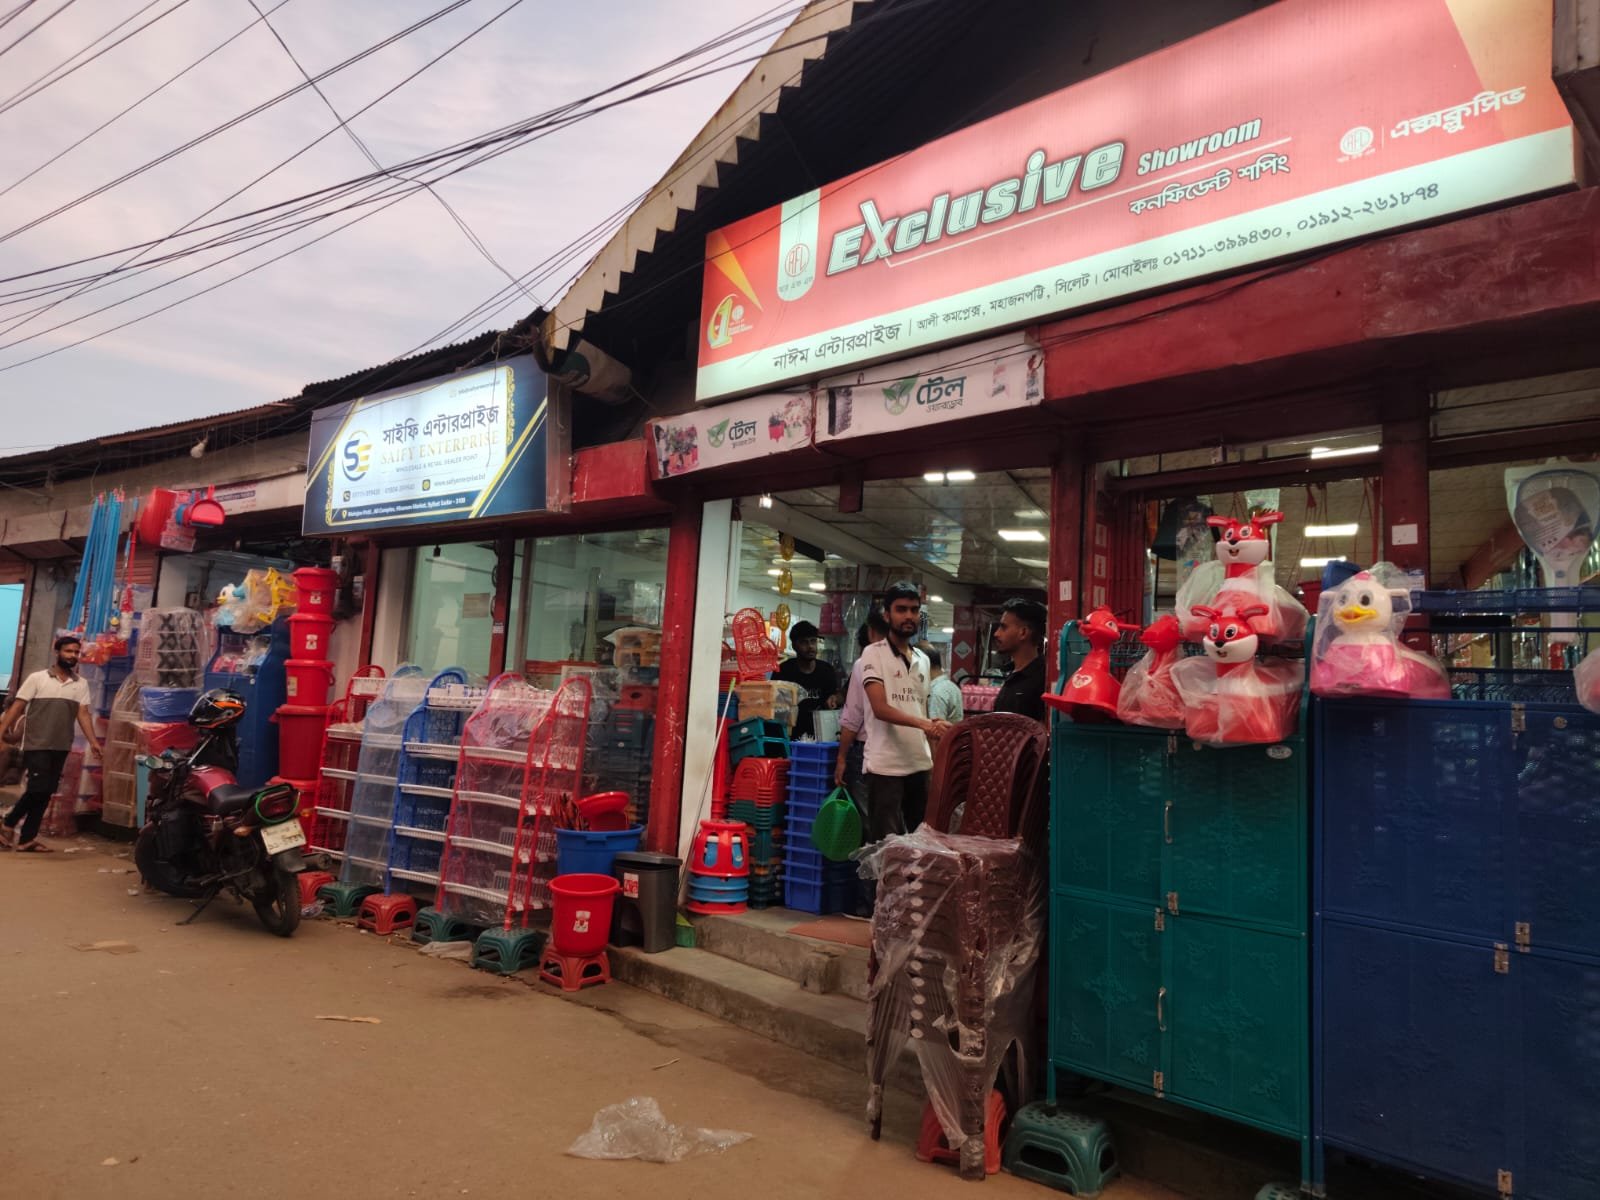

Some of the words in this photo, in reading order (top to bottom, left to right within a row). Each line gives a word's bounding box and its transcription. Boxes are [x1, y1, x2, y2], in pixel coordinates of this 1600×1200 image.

[1390, 86, 1527, 138] এক্সক্লুসিভ
[825, 139, 1125, 277] Exclusive
[1136, 118, 1262, 177] Showroom
[1129, 166, 1231, 216] কনফিডেন্ট
[1237, 153, 1292, 183] শপিং
[773, 347, 810, 369] নাঈম
[814, 322, 902, 359] এন্টারপ্রাইজ
[917, 312, 939, 331] আলী
[1055, 273, 1091, 295] সিলেট
[1296, 182, 1440, 231] ০১৯১২-২৬১৮৭৪
[916, 376, 968, 406] টেল
[380, 446, 414, 465] SAIFY
[418, 430, 500, 459] ENTERPRISE
[383, 417, 419, 446] সাইফি
[422, 404, 500, 437] এন্টারপ্রাইজ
[728, 420, 759, 441] টেল
